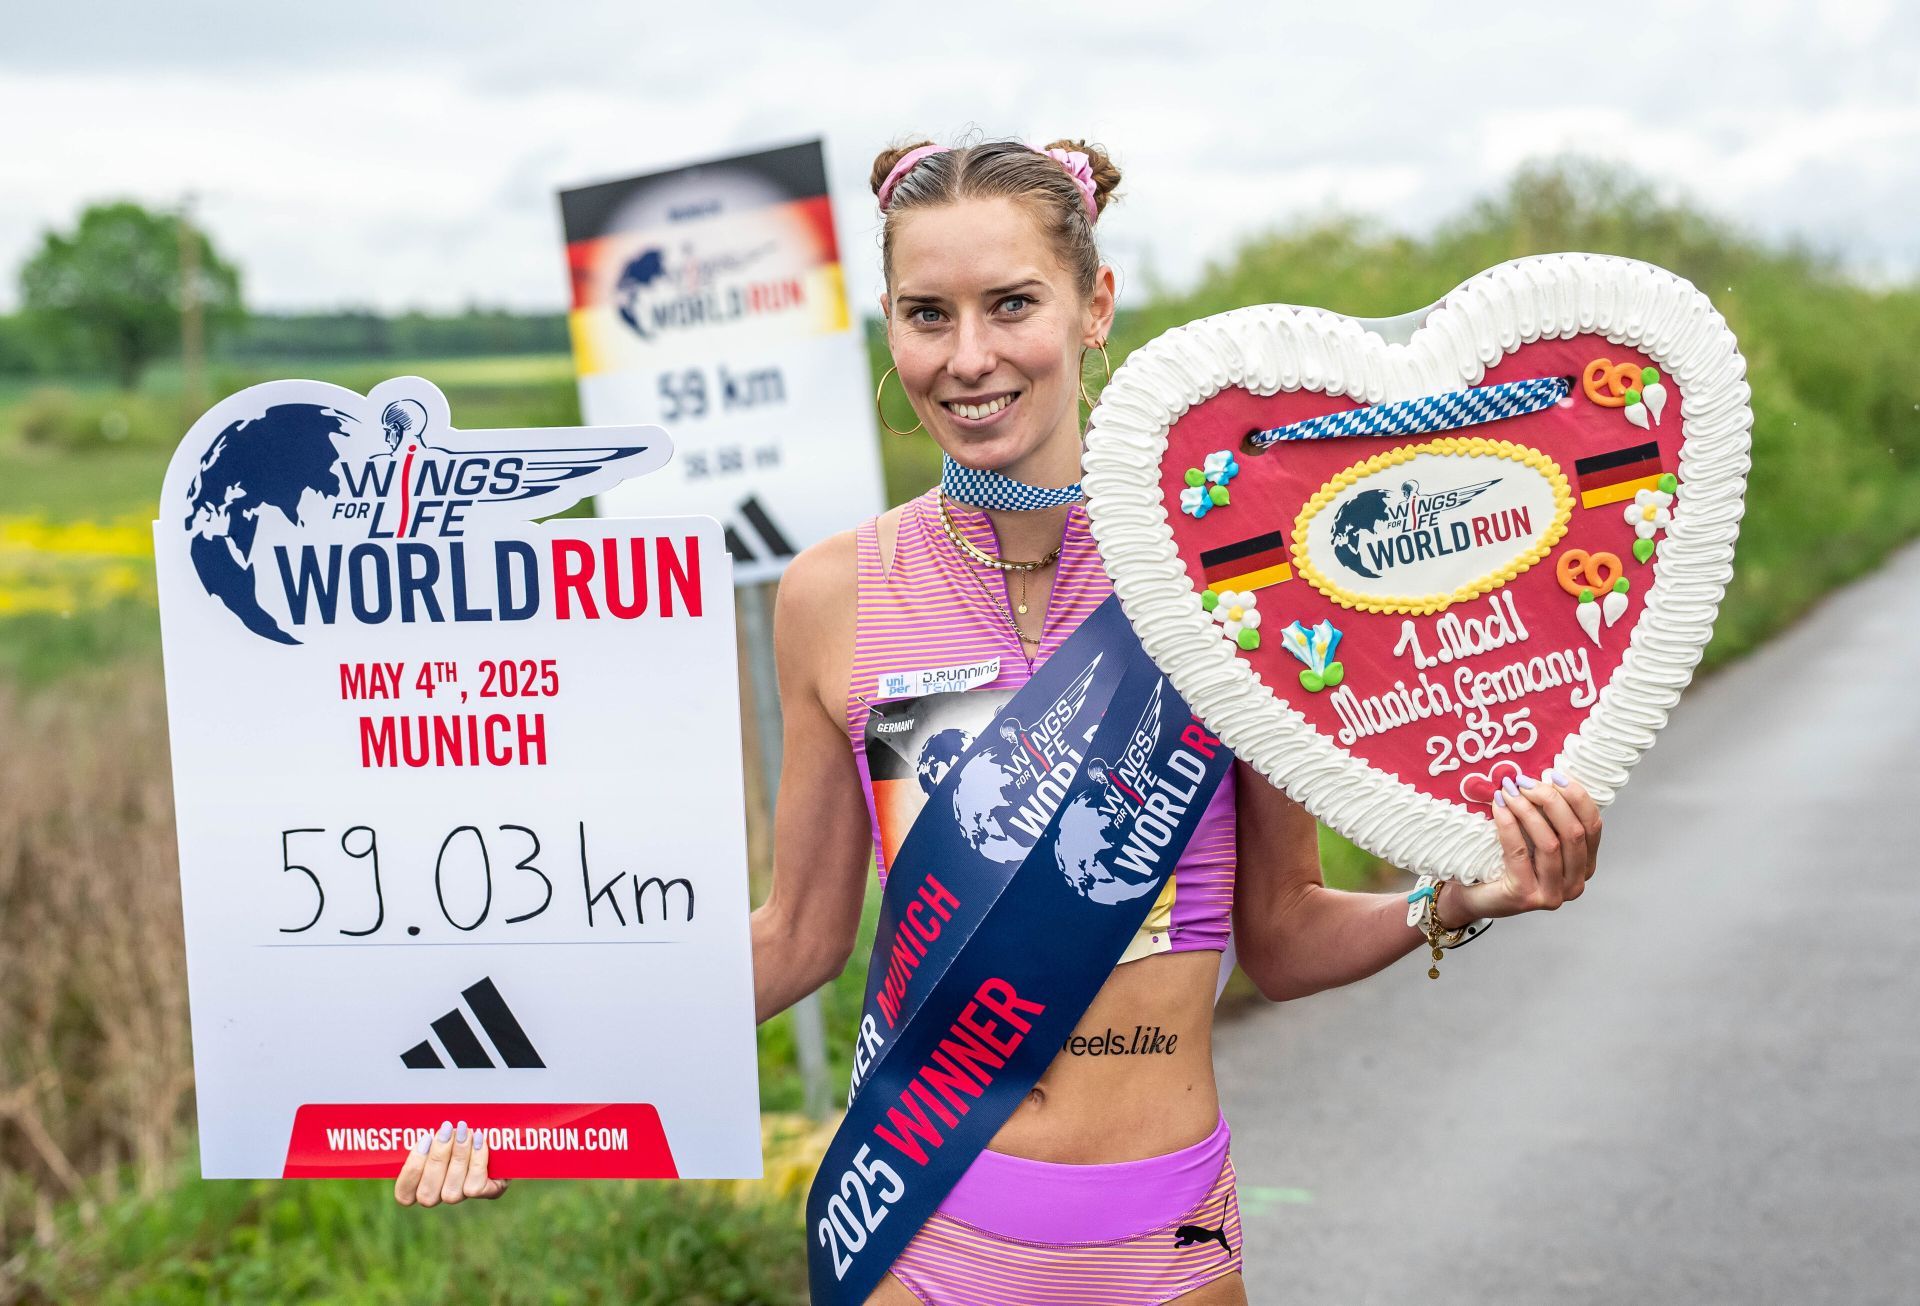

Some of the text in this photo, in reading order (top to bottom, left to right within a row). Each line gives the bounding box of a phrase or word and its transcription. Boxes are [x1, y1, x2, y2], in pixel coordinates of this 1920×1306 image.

[332, 502, 370, 519] FOR
[1387, 520, 1402, 529] FOR
[1367, 506, 1532, 571] WORLD RUN
[275, 536, 702, 624] WORLD RUN
[340, 662, 404, 700] MAY
[478, 659, 560, 698] 2025
[886, 675, 904, 687] uni
[889, 685, 910, 696] per
[923, 680, 966, 693] TEAM
[359, 713, 547, 768] MUNICH
[877, 719, 914, 732] GERMANY
[1426, 707, 1538, 777] 2025
[1015, 770, 1031, 789] FOR
[1113, 808, 1127, 829] FOR
[1114, 750, 1206, 877] WORLD
[279, 821, 695, 936] 59.03 km
[876, 873, 961, 1029] MUNICH
[818, 977, 1046, 1281] 2025 WINNER
